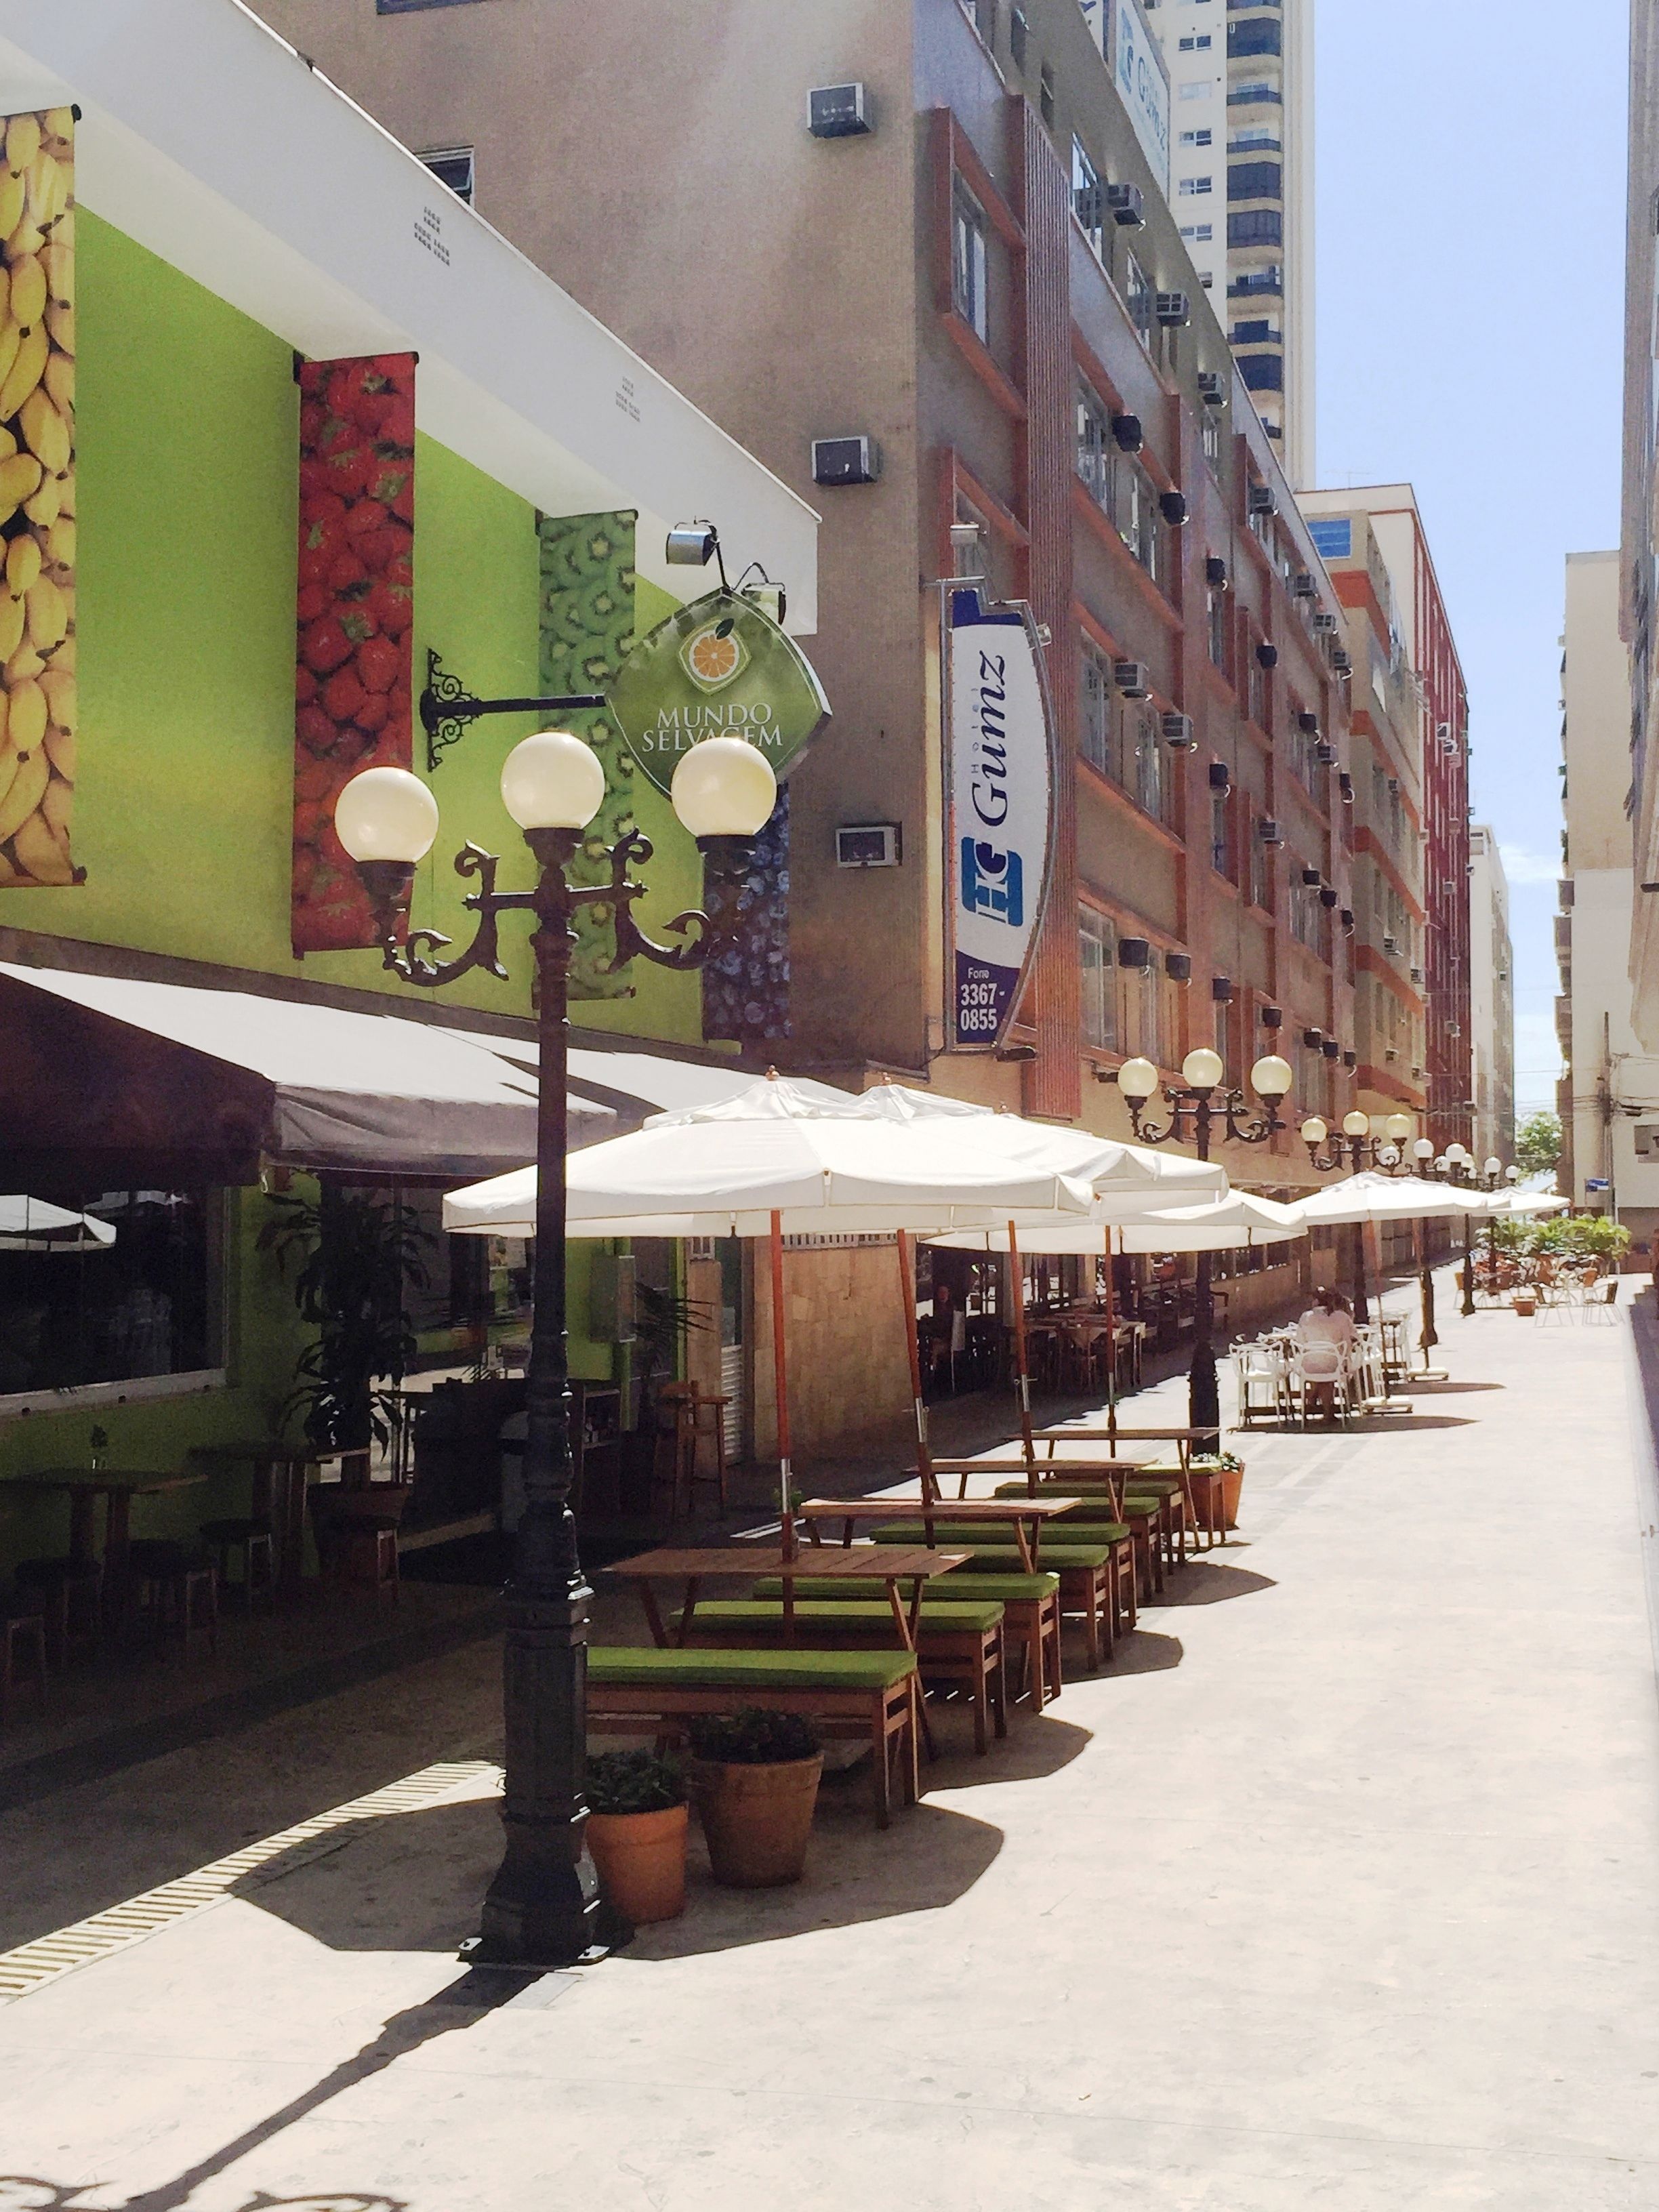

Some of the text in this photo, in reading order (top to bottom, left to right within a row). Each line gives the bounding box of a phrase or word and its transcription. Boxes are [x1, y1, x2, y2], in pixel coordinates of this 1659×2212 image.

[657, 702, 772, 729] MUNDO
[972, 650, 1008, 827] Gumz
[961, 983, 1005, 1006] 3367-
[960, 1008, 998, 1031] 0855
